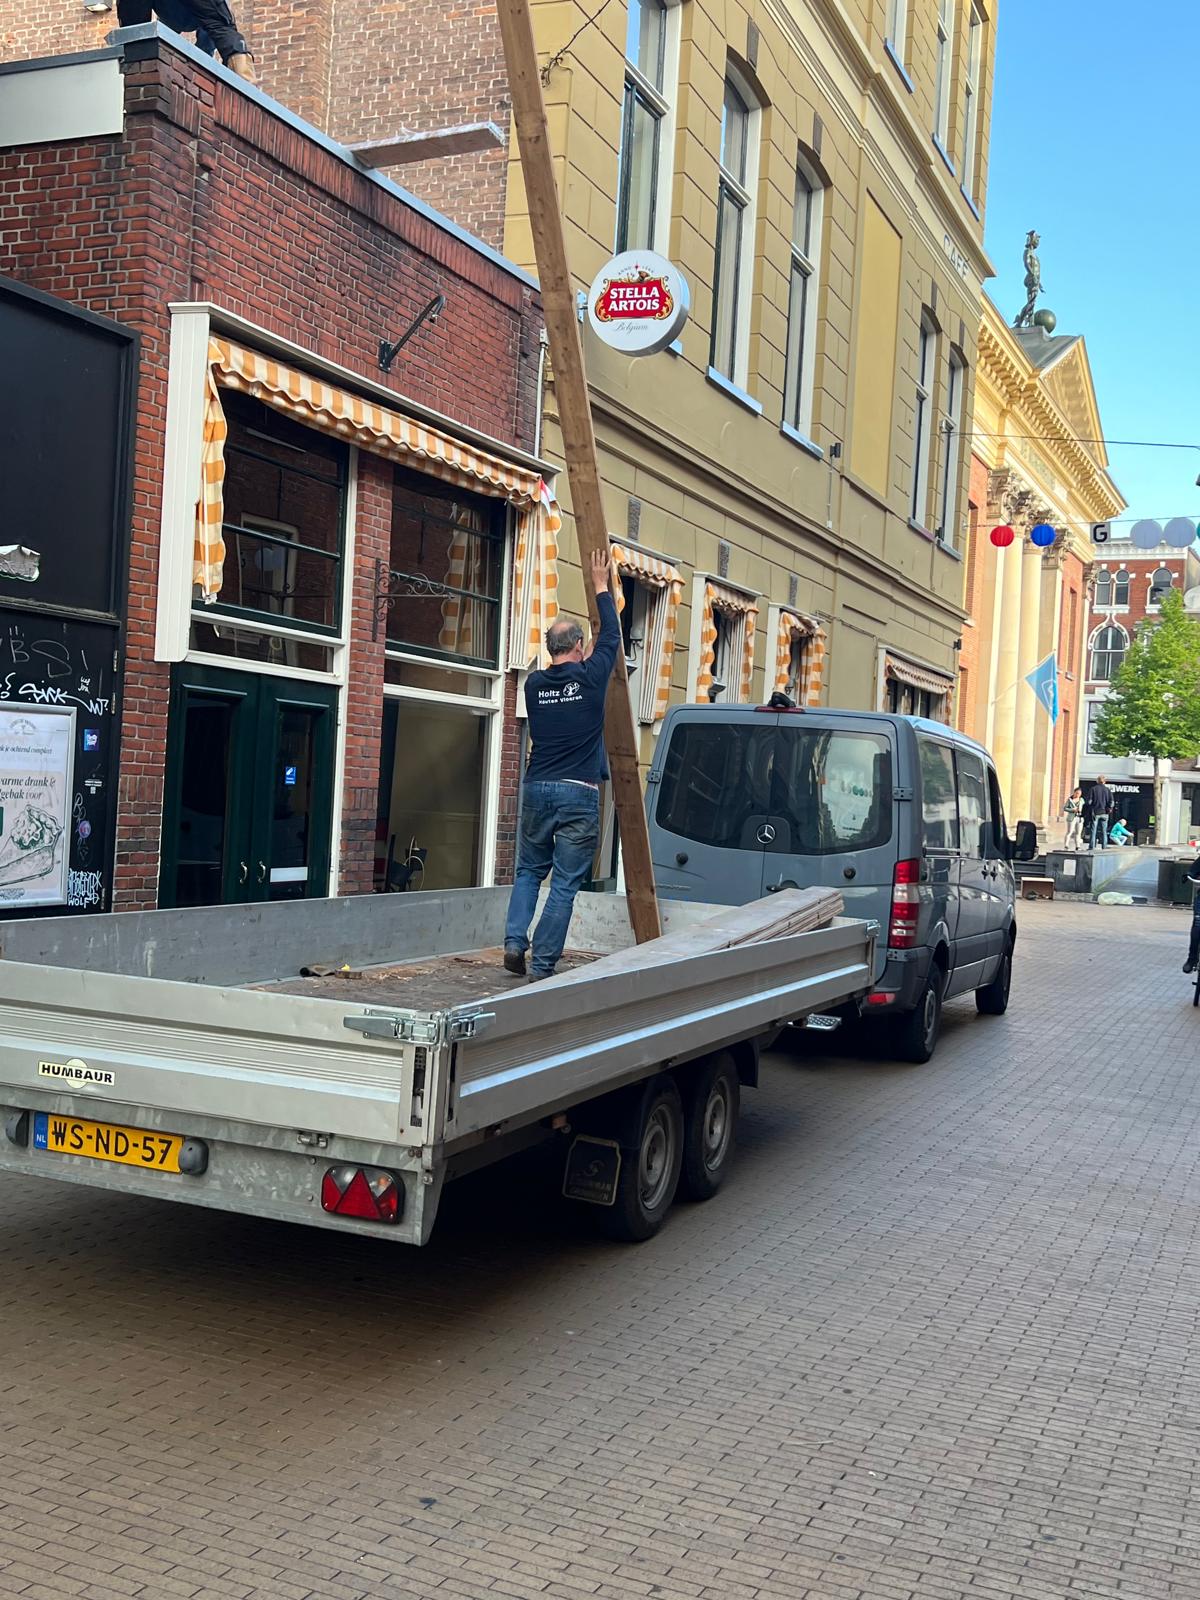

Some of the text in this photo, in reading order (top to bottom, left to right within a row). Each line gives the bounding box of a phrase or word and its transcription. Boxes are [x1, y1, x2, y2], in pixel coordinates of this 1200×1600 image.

[610, 286, 660, 299] STELLA
[608, 299, 660, 311] ARTOIS
[615, 321, 648, 334] Belgium
[1093, 524, 1108, 543] G
[538, 690, 560, 698] Holtz
[24, 776, 48, 787] drank
[68, 896, 89, 909] WOLF
[41, 1062, 113, 1084] HUMBAUR
[36, 1120, 173, 1165] NL WS-ND-57
